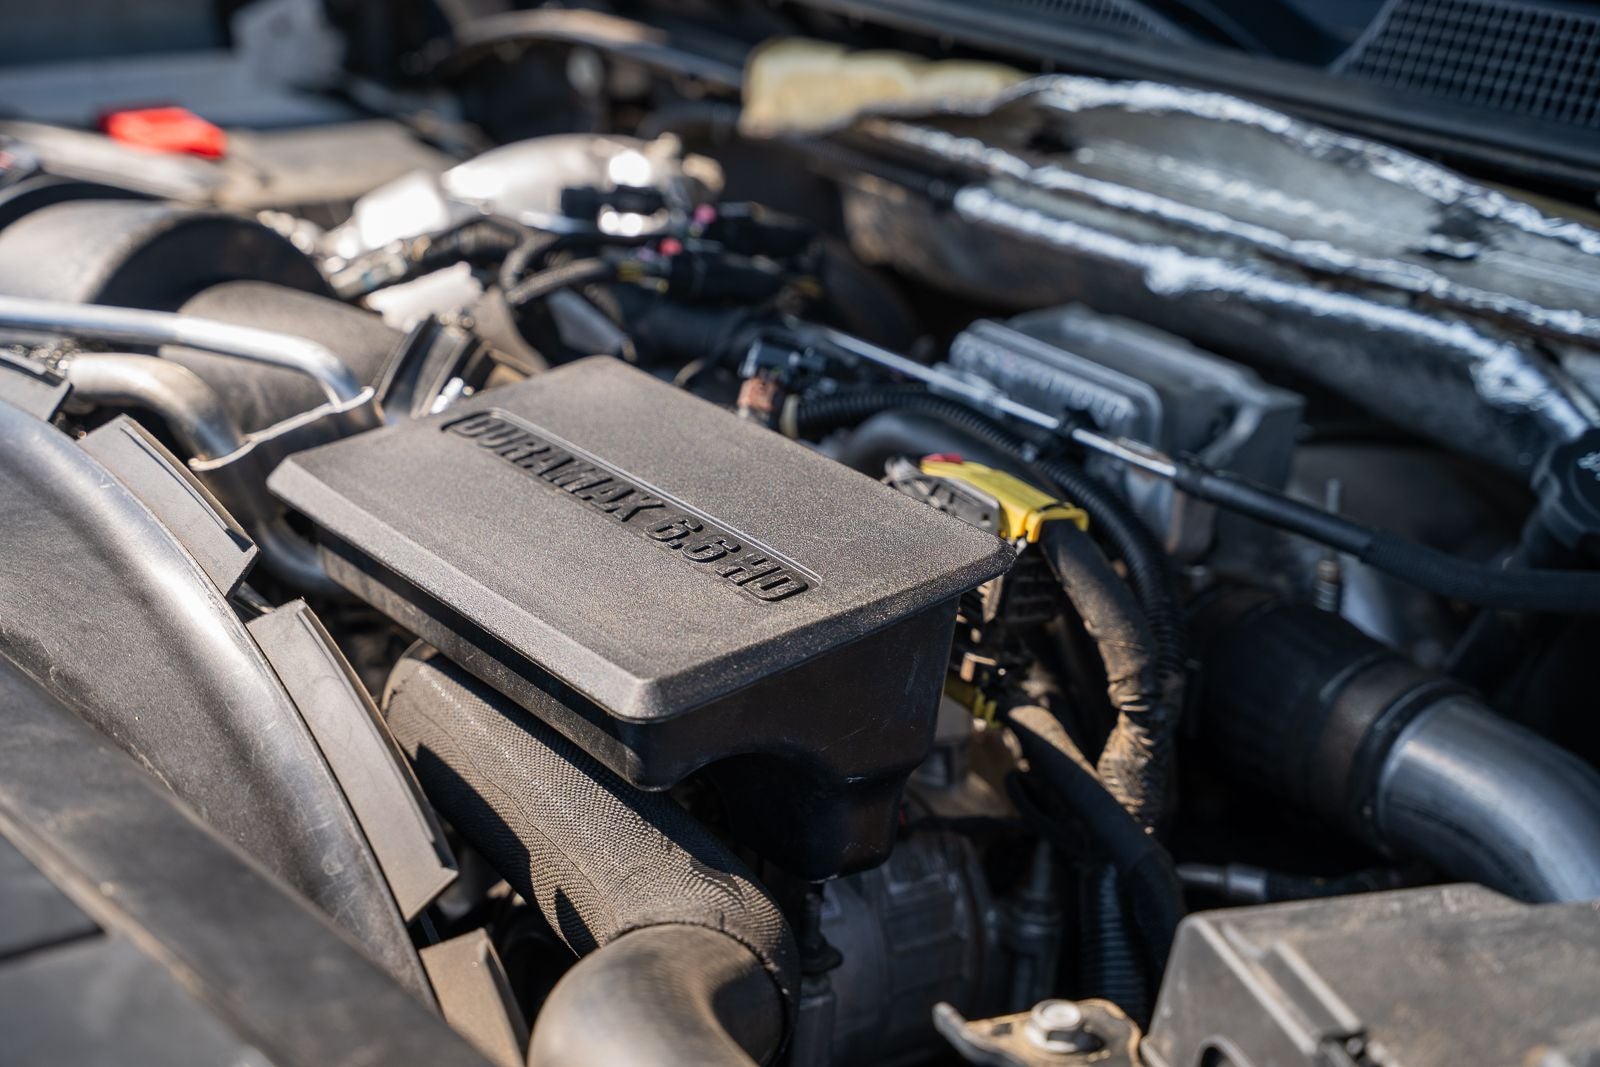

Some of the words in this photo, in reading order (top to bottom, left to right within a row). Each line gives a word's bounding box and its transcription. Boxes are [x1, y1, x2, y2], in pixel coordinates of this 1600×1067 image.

[449, 413, 666, 522] DURAMAX
[645, 515, 741, 563] 6.6
[715, 554, 808, 601] HD
